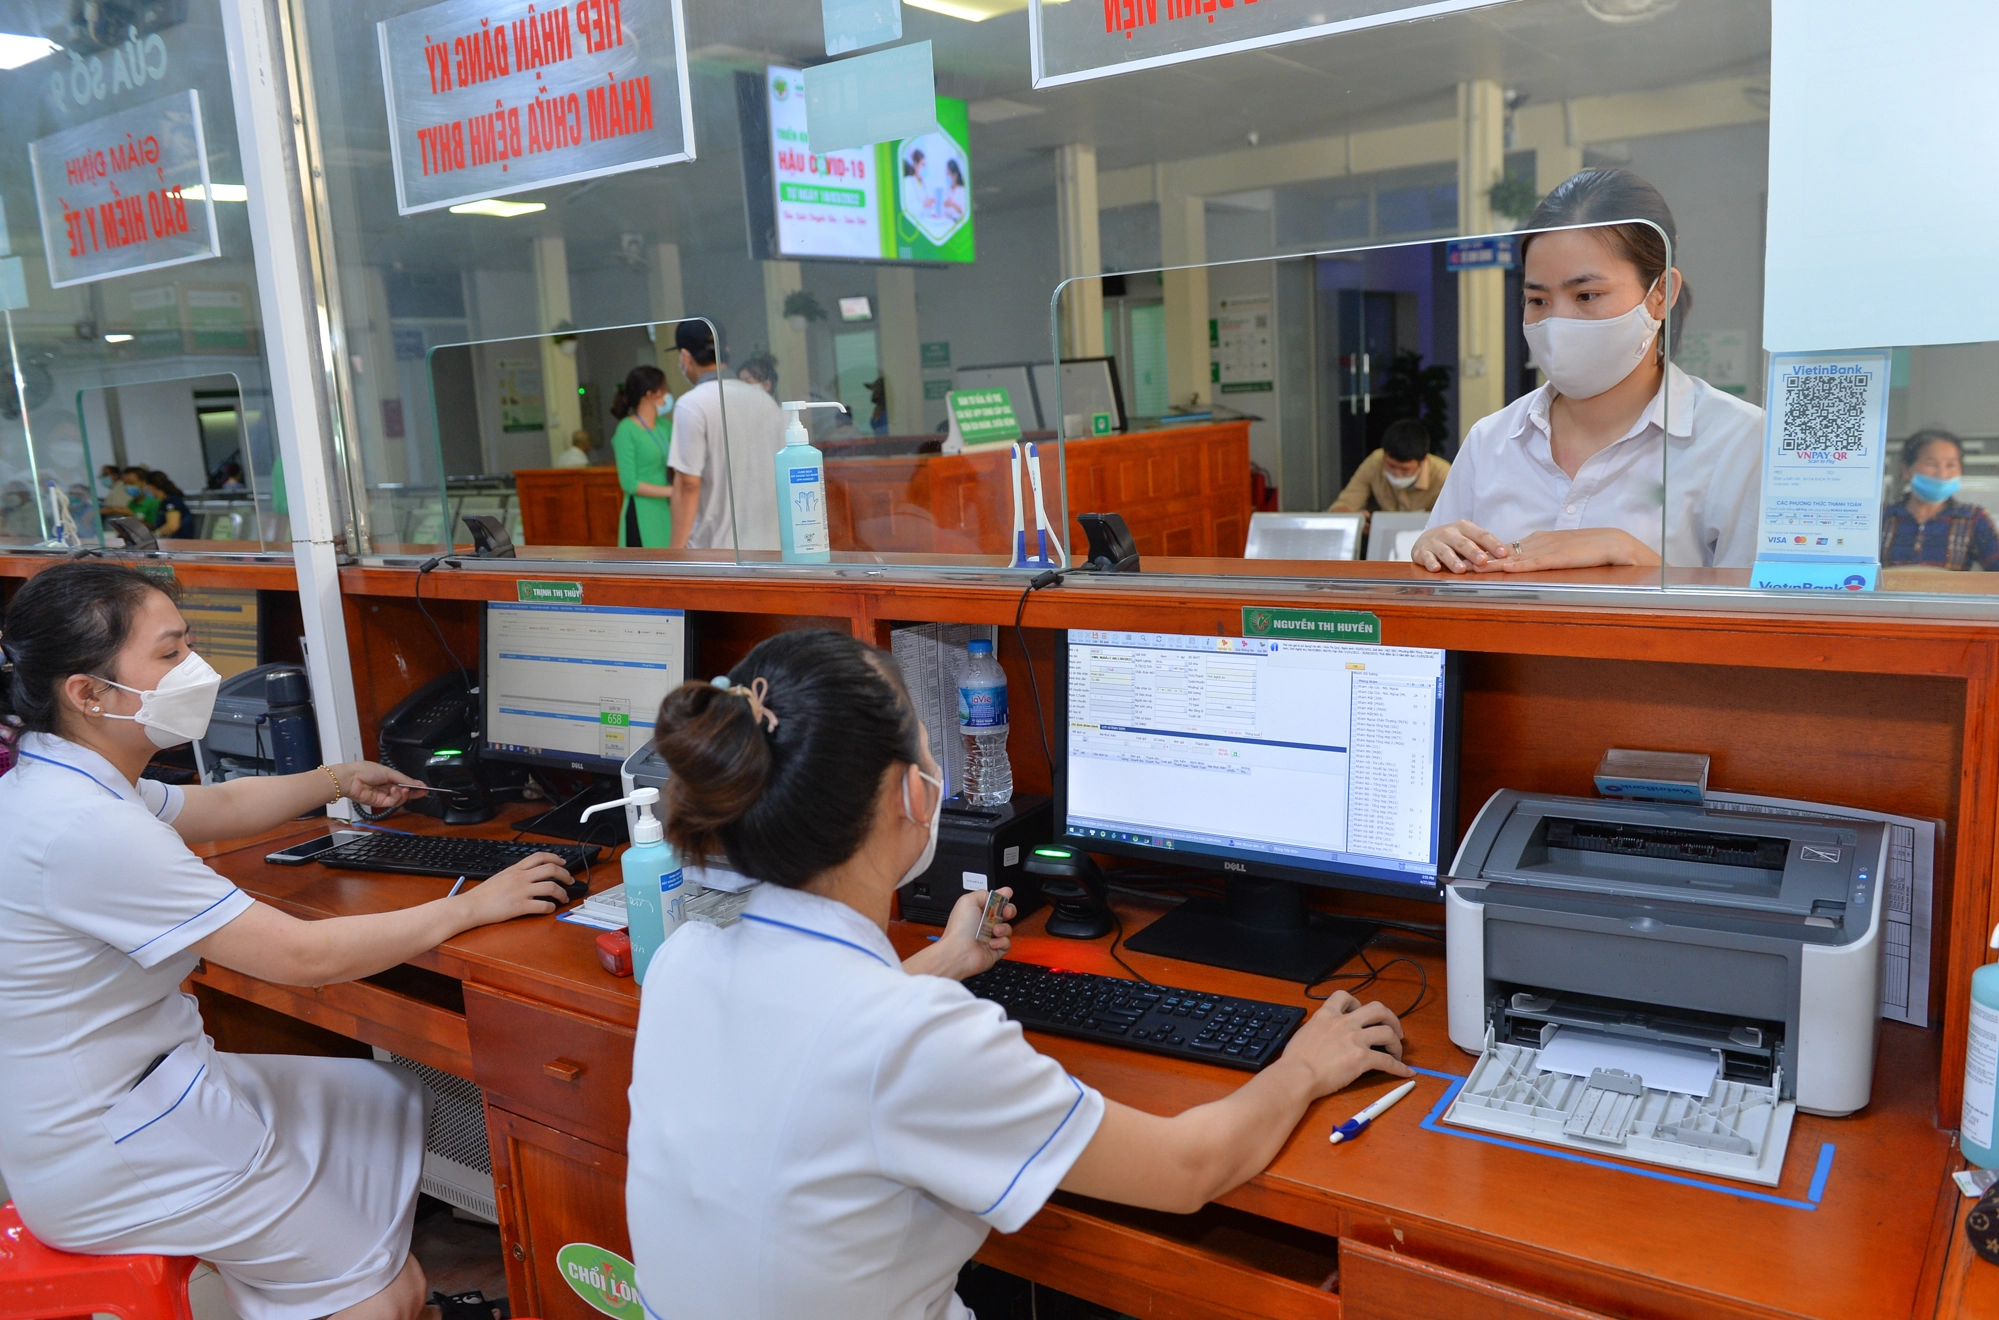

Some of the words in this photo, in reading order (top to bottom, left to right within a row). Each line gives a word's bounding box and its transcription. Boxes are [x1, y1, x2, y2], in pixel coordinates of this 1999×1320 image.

[778, 148, 805, 177] HẬU
[1793, 364, 1863, 375] VietinBank
[533, 589, 551, 597] TRỊNH
[553, 589, 563, 598] THỊ
[1274, 619, 1315, 630] NGUYỄN
[1318, 622, 1334, 633] THỊ
[608, 714, 621, 724] 658
[1620, 784, 1693, 795] VietinBank
[1224, 862, 1246, 872] DELL
[568, 1262, 606, 1291] CHỔI
[611, 1279, 642, 1306] LÔN
